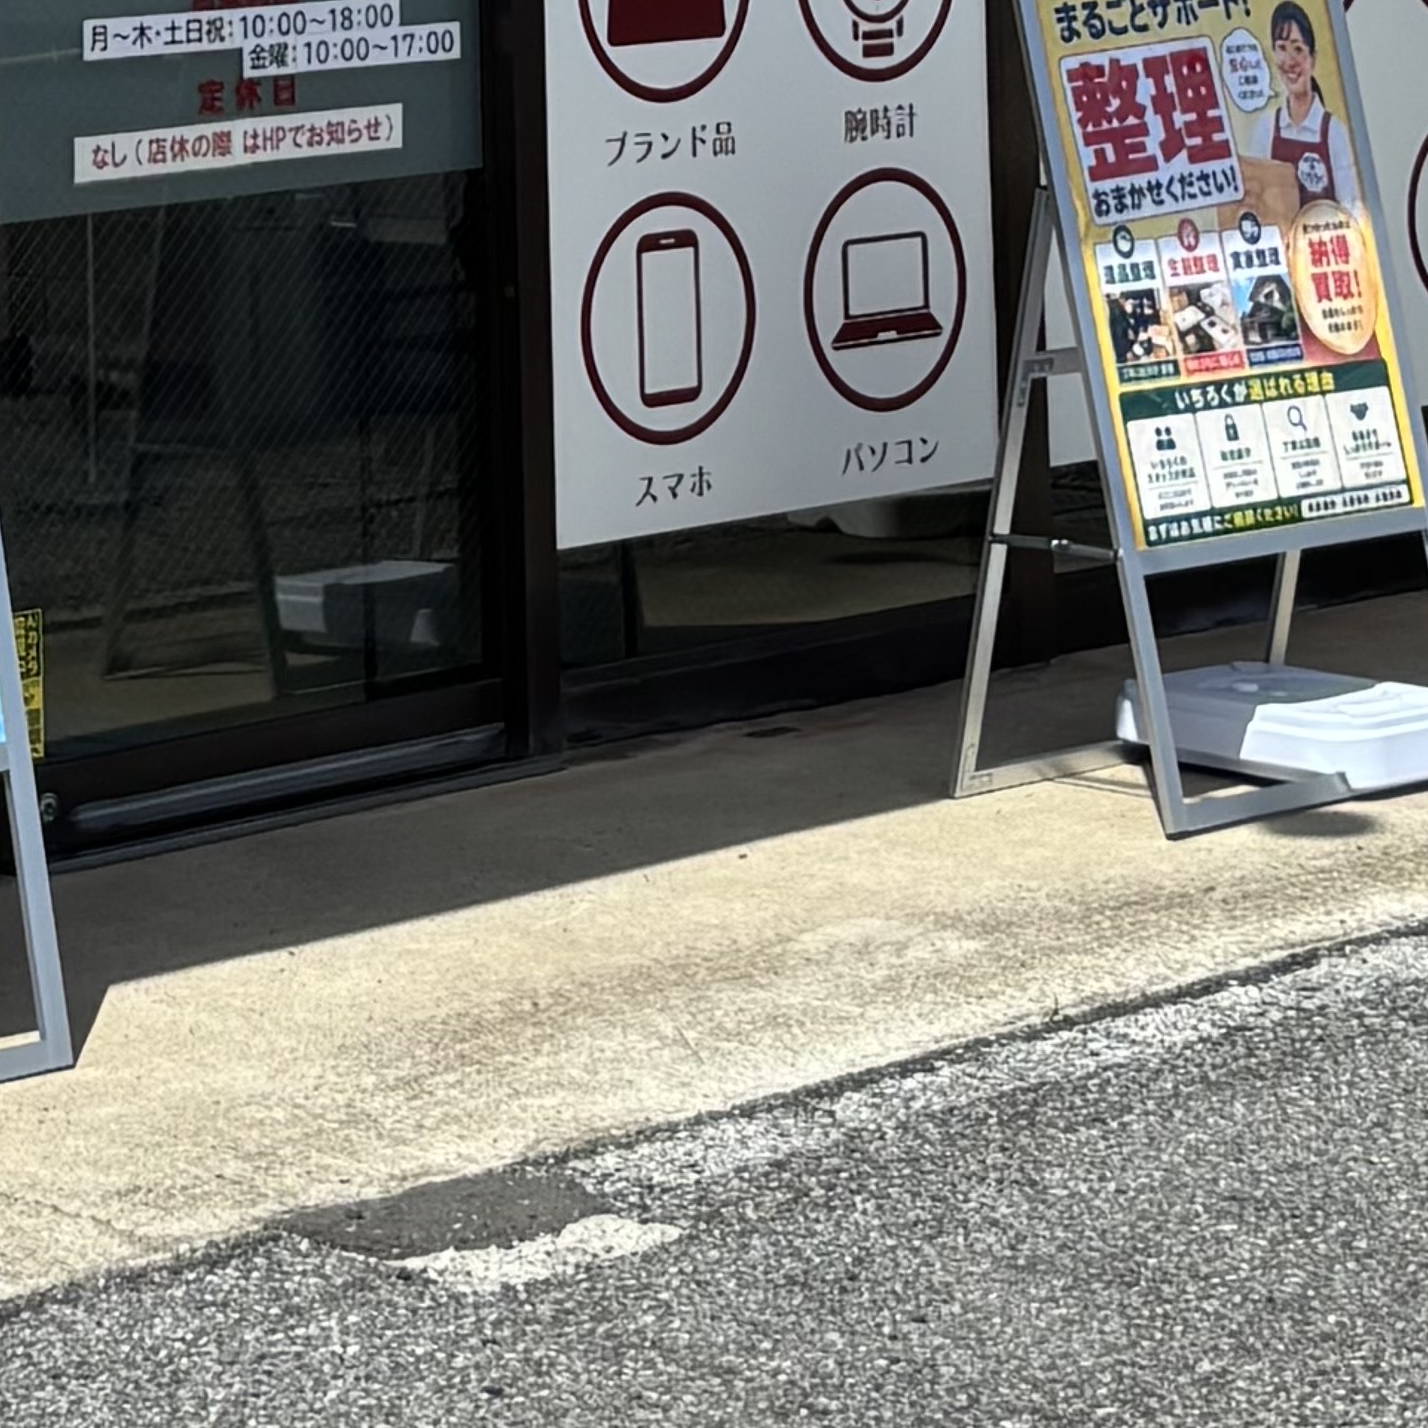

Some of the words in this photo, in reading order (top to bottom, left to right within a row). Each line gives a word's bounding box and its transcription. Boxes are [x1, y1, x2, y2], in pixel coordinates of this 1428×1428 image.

[197, 78, 298, 116] 定休日
[1066, 46, 1233, 184] 整理
[605, 120, 737, 168] ブランド品
[843, 103, 919, 144] 腕時計
[1090, 164, 1241, 219] おまかせください!
[1310, 269, 1363, 304] 買取!
[1174, 370, 1336, 411] いちろくが選ばれる理由
[841, 436, 940, 477] パソコン
[635, 465, 713, 507] スマホ
